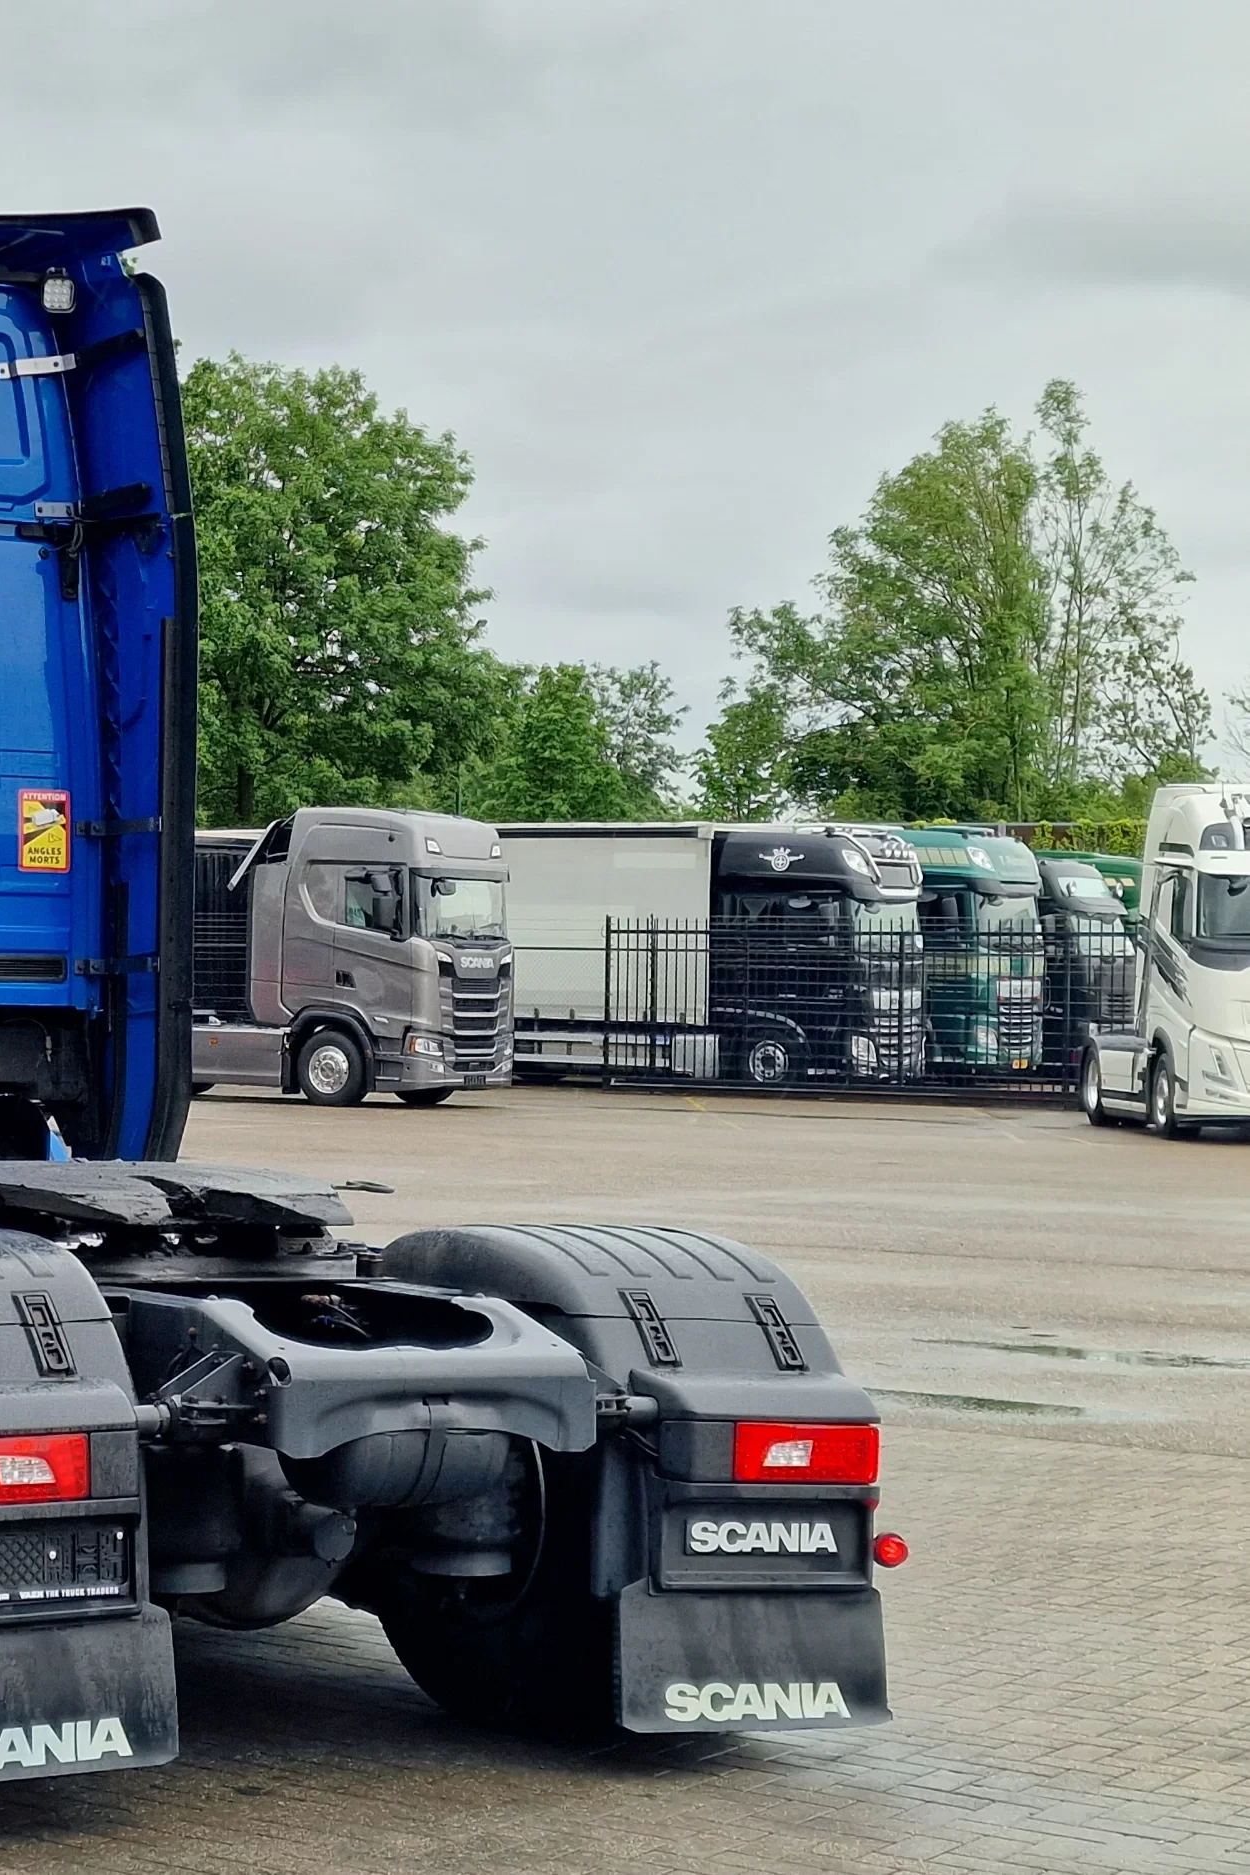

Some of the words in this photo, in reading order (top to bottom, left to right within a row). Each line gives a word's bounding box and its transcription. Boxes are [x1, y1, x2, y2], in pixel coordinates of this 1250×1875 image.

[23, 792, 66, 801] ATTENTION
[27, 847, 61, 855] ANGLES
[29, 856, 60, 864] MORTS
[460, 956, 494, 968] SCANIA
[690, 1521, 838, 1553] SCANIA
[46, 1589, 60, 1598] THE
[61, 1588, 85, 1597] TRUCK
[86, 1586, 119, 1596] TRADERS
[664, 1682, 851, 1722] SCANIA
